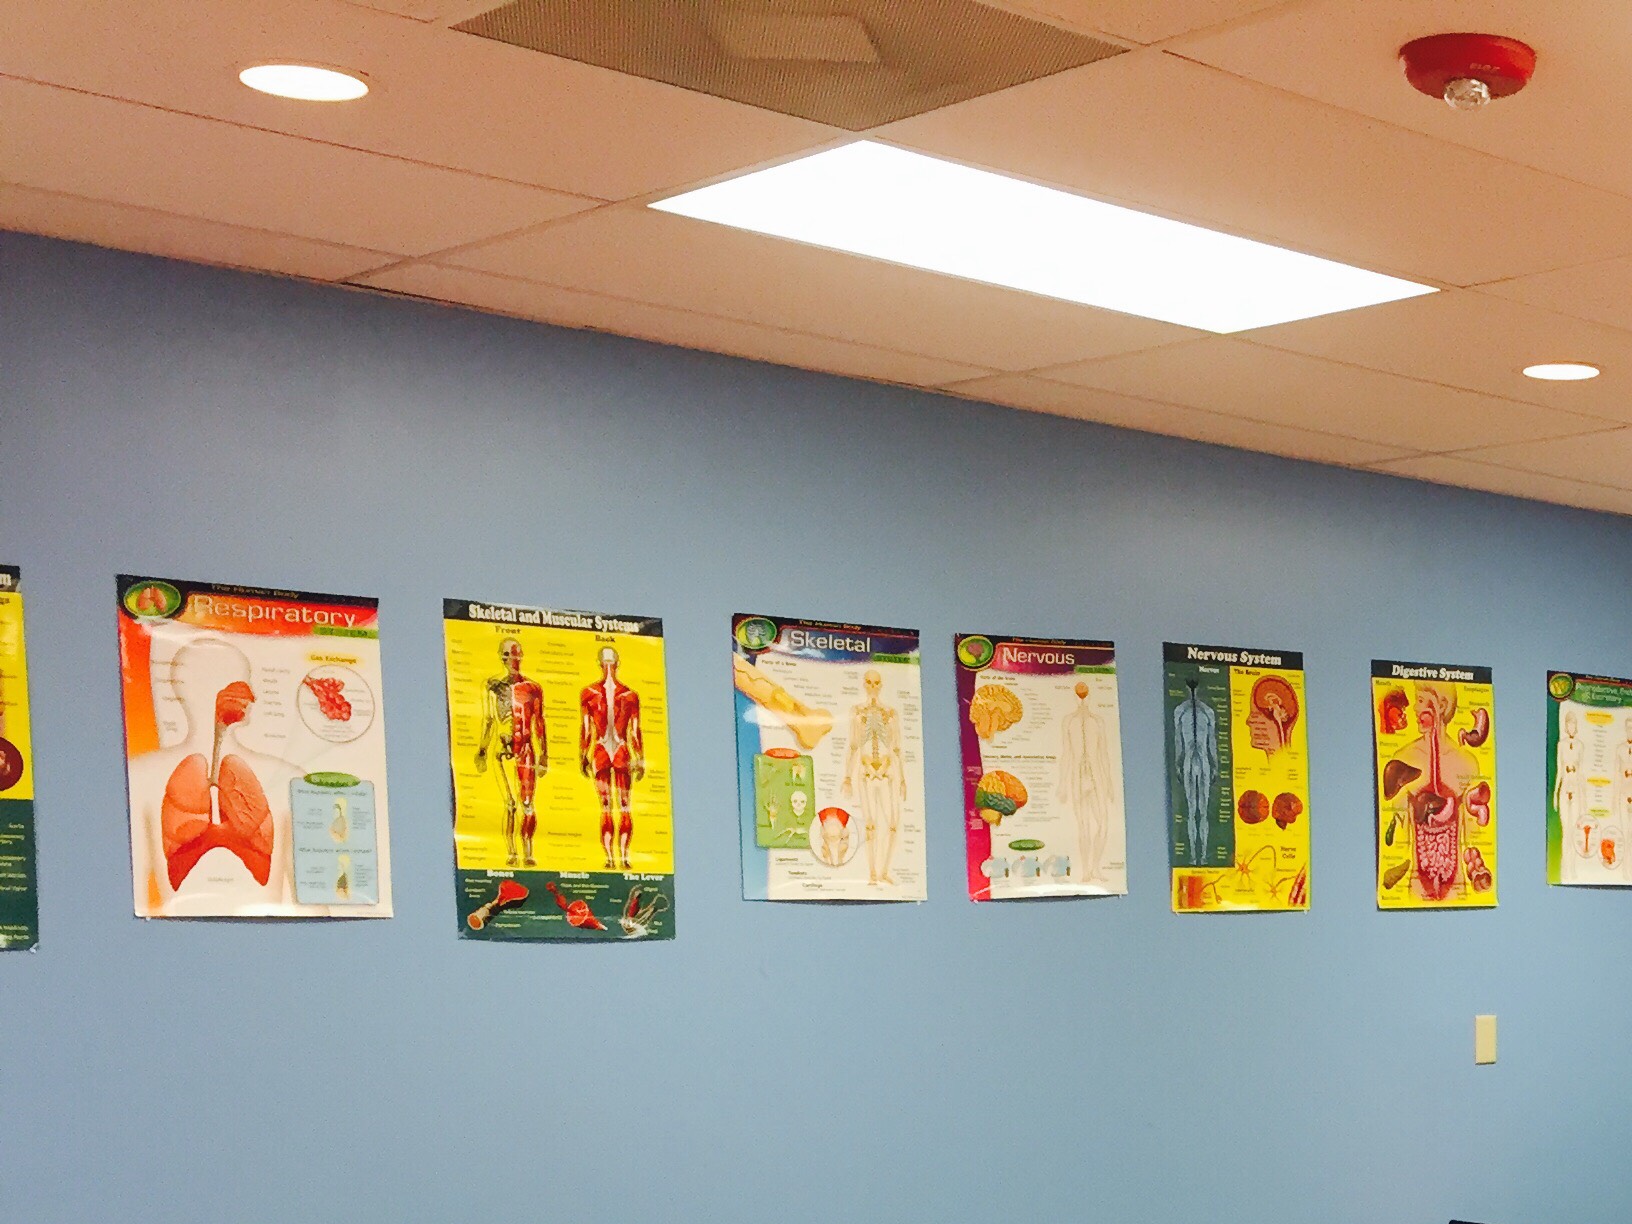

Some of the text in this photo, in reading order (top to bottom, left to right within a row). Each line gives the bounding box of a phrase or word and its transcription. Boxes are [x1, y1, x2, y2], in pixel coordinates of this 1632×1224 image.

[192, 594, 356, 628] Respiratory
[468, 603, 640, 633] Skeletal and Muscular Systems
[790, 630, 871, 653] Skeletal
[1002, 647, 1075, 665] Nervous
[1187, 646, 1282, 666] Nervous System
[1391, 664, 1474, 681] Digestive System
